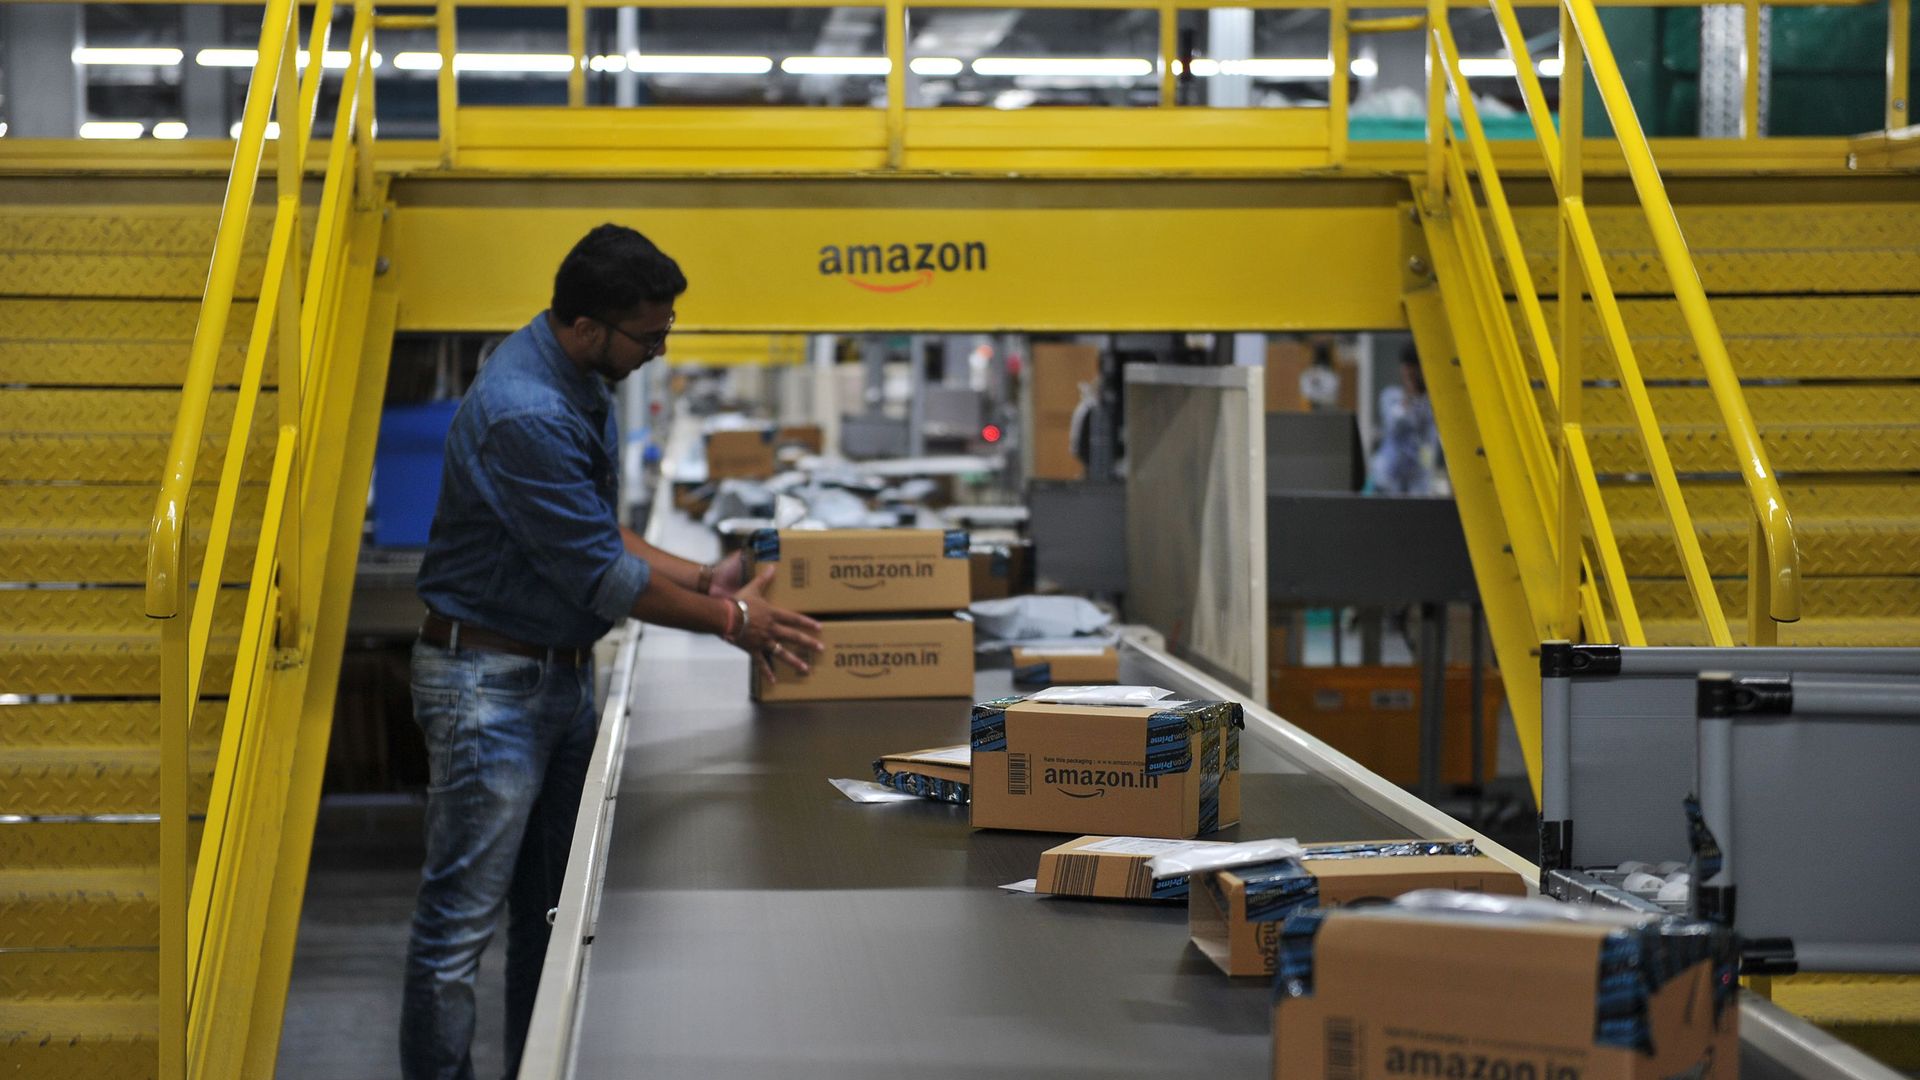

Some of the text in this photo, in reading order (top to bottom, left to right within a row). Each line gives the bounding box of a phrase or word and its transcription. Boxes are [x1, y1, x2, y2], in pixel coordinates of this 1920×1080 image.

[818, 241, 987, 275] amazon
[829, 562, 934, 579] amazon.in
[834, 650, 939, 667] amazon.in
[1066, 758, 1093, 766] packaging
[1044, 767, 1159, 788] amazon.in
